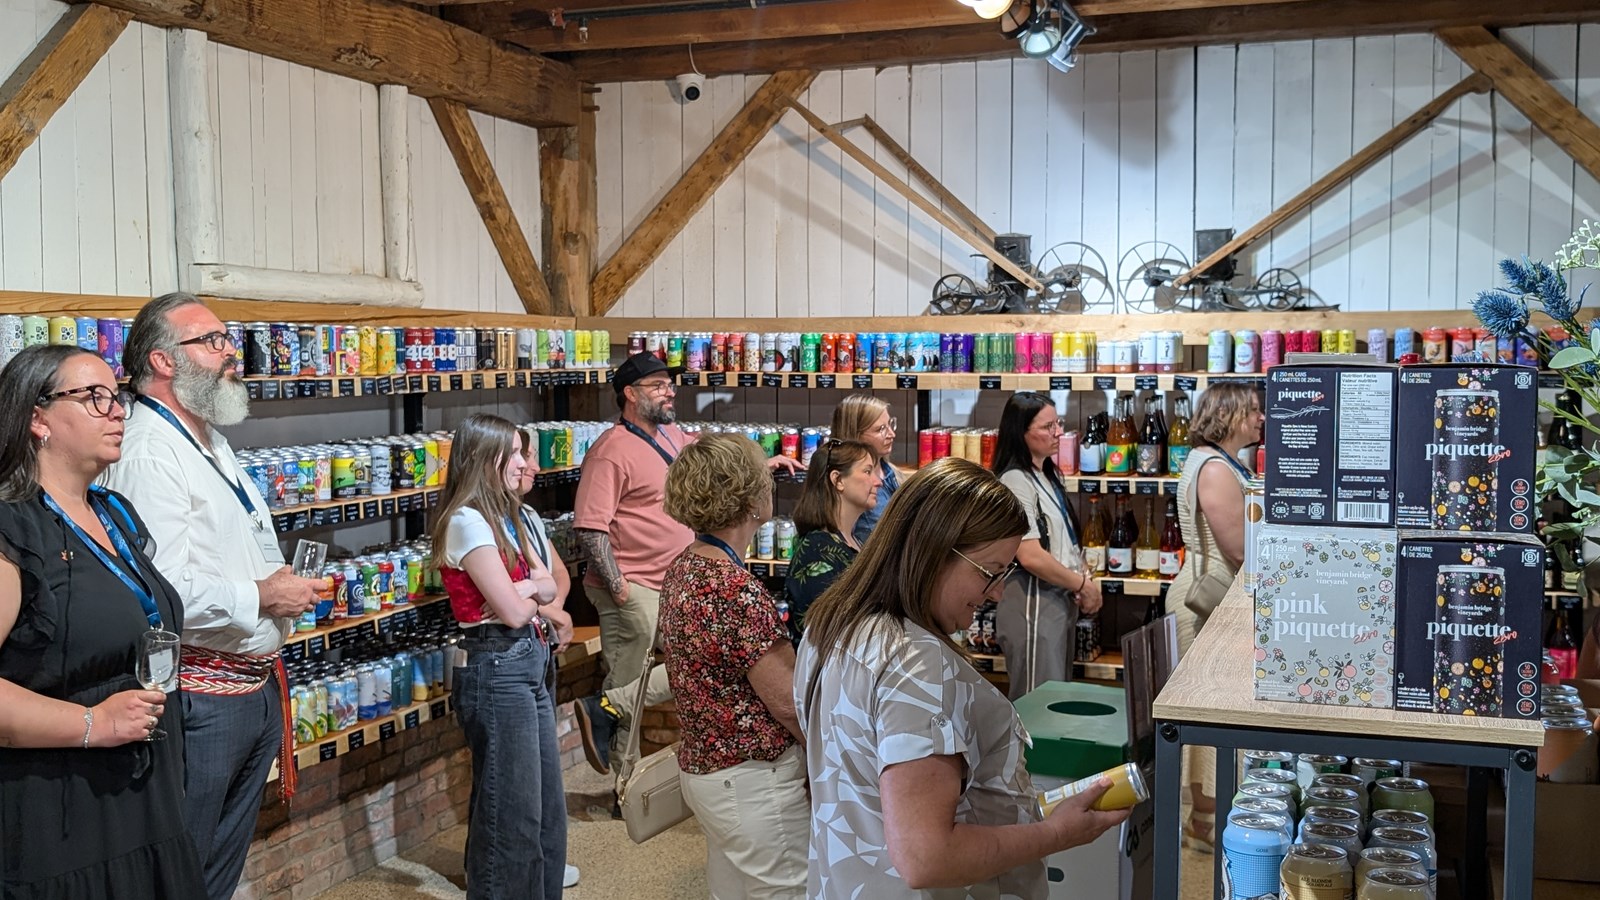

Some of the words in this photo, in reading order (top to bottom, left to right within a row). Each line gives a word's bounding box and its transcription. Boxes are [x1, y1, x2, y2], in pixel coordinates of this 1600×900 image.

[1271, 371, 1277, 382] 4
[1401, 372, 1406, 383] 4
[1278, 388, 1321, 401] piquette
[1424, 438, 1506, 461] piquette
[1261, 545, 1271, 559] 4
[1401, 545, 1406, 557] 4
[1316, 569, 1349, 580] benjamin
[1349, 570, 1372, 580] bridge
[1316, 578, 1348, 586] vineyards
[1273, 592, 1328, 619] pink
[1448, 603, 1474, 611] benjamin
[1474, 604, 1492, 612] bridge
[1273, 614, 1371, 643] piquette
[1426, 616, 1512, 641] piquette
